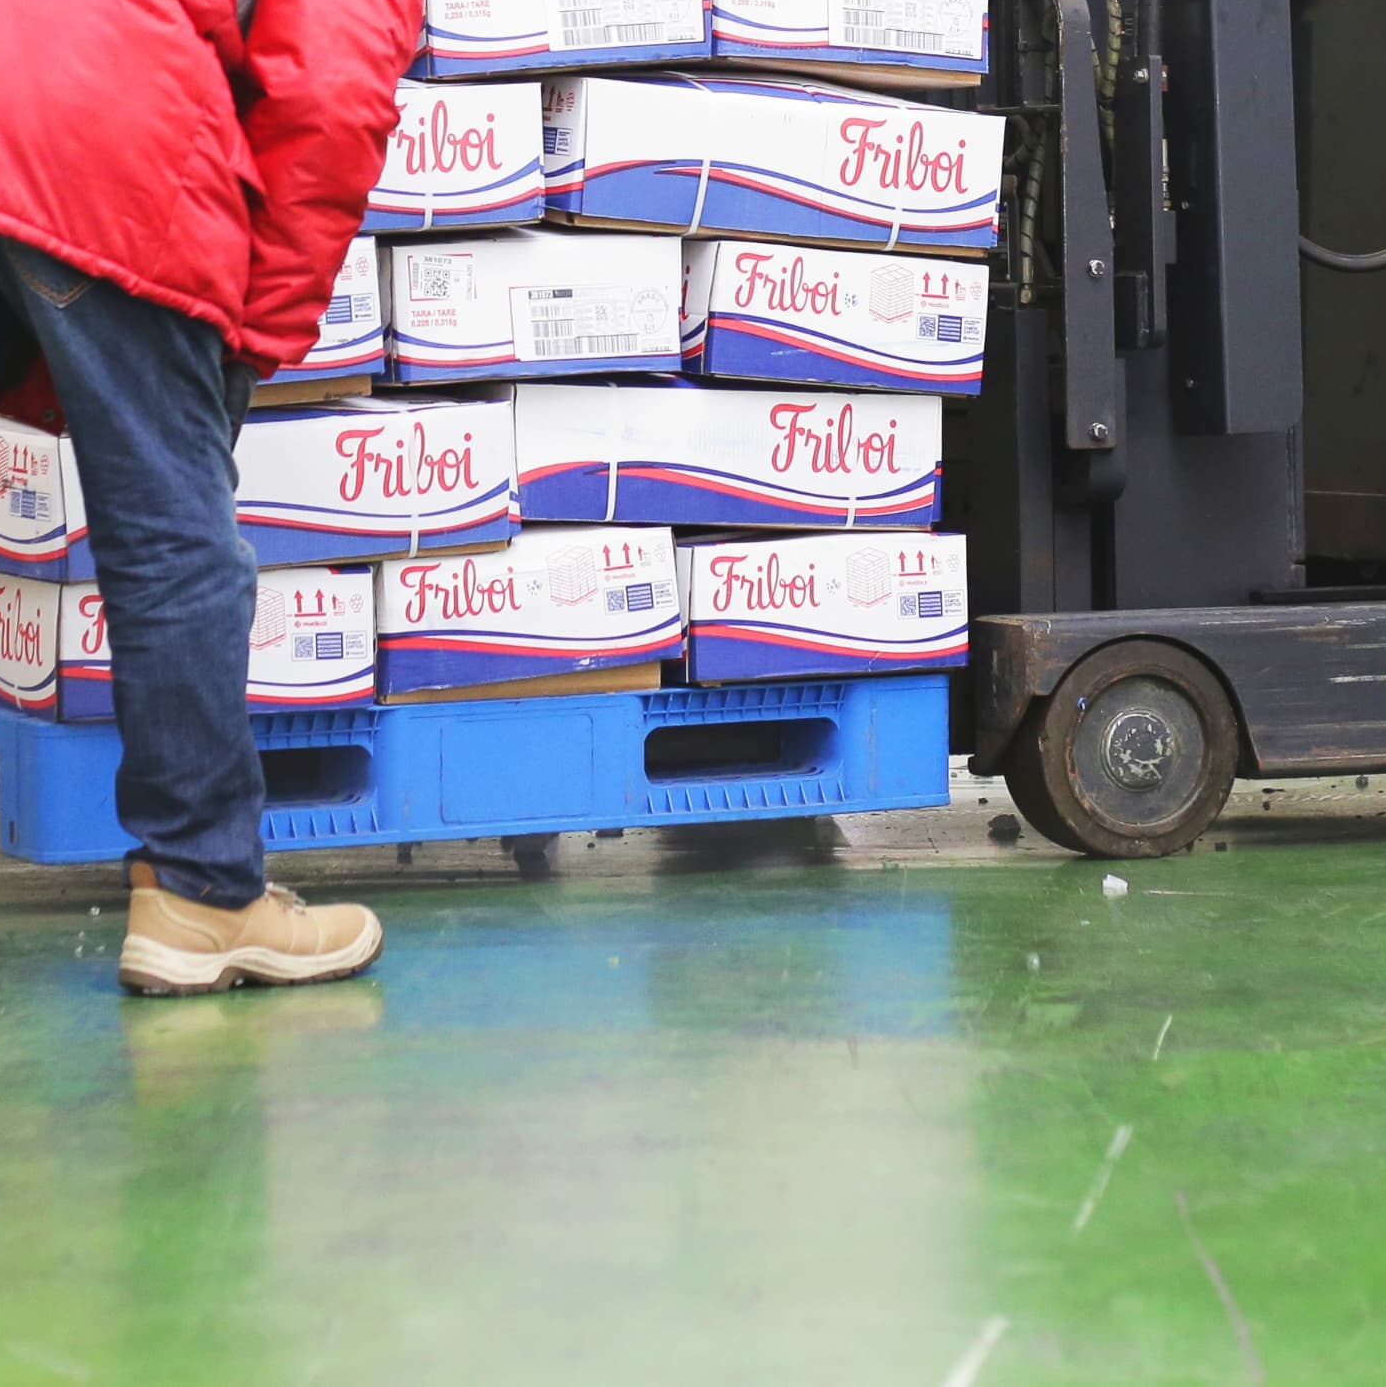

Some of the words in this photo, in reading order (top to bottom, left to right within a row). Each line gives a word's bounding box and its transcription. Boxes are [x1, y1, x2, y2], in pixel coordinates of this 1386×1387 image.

[839, 117, 968, 194] Friboi
[734, 252, 842, 316] Friboi
[335, 421, 479, 502] Friboi
[769, 402, 901, 474] Friboi
[399, 558, 522, 623] Friboi
[709, 552, 821, 612] Friboi
